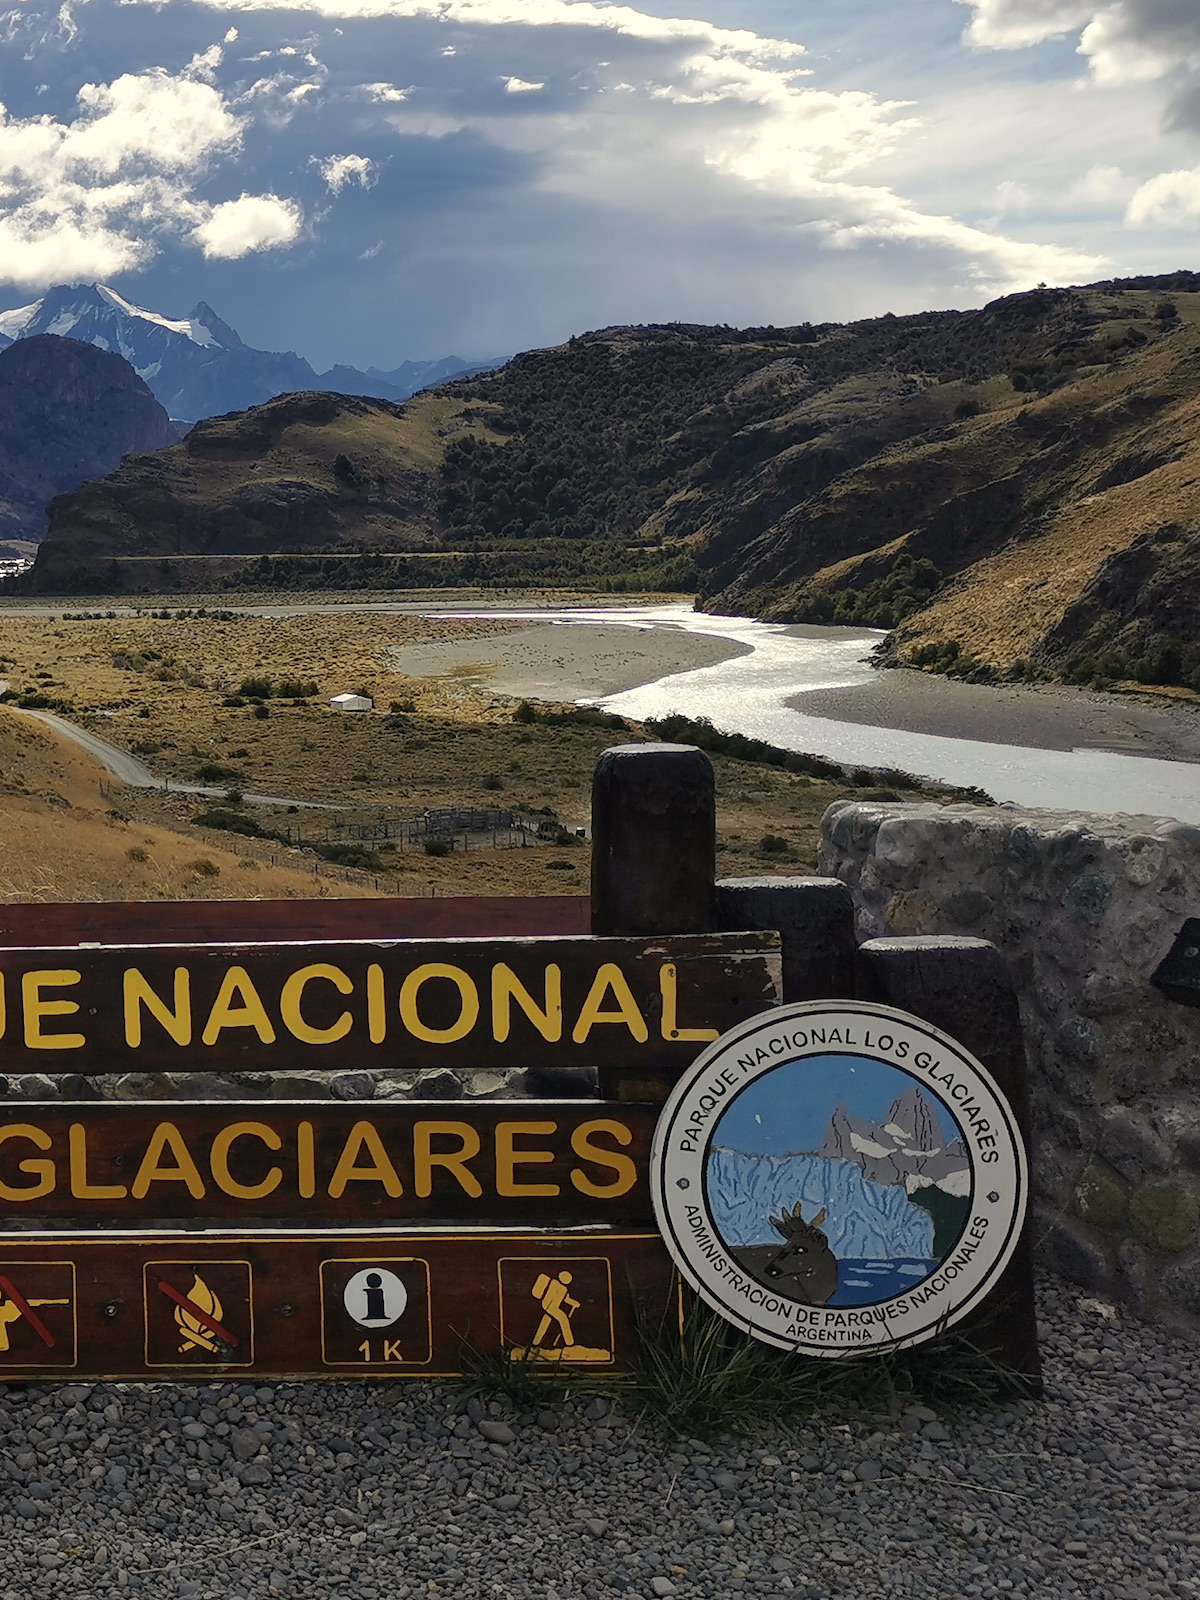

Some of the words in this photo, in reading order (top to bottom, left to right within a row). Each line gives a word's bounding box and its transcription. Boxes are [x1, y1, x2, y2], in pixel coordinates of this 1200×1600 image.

[122, 962, 720, 1048] NACIONAL
[680, 1067, 740, 1152] PARQUE
[736, 1028, 857, 1073] NACIONAL
[864, 1031, 910, 1059] LOS
[913, 1051, 999, 1164] GLACIARES
[684, 1205, 793, 1319] ADMINISTRACION
[796, 1308, 820, 1326] DE
[824, 1299, 909, 1327] PARQUES
[910, 1215, 990, 1309] NACIONALES
[785, 1323, 873, 1342] ARGENTINA
